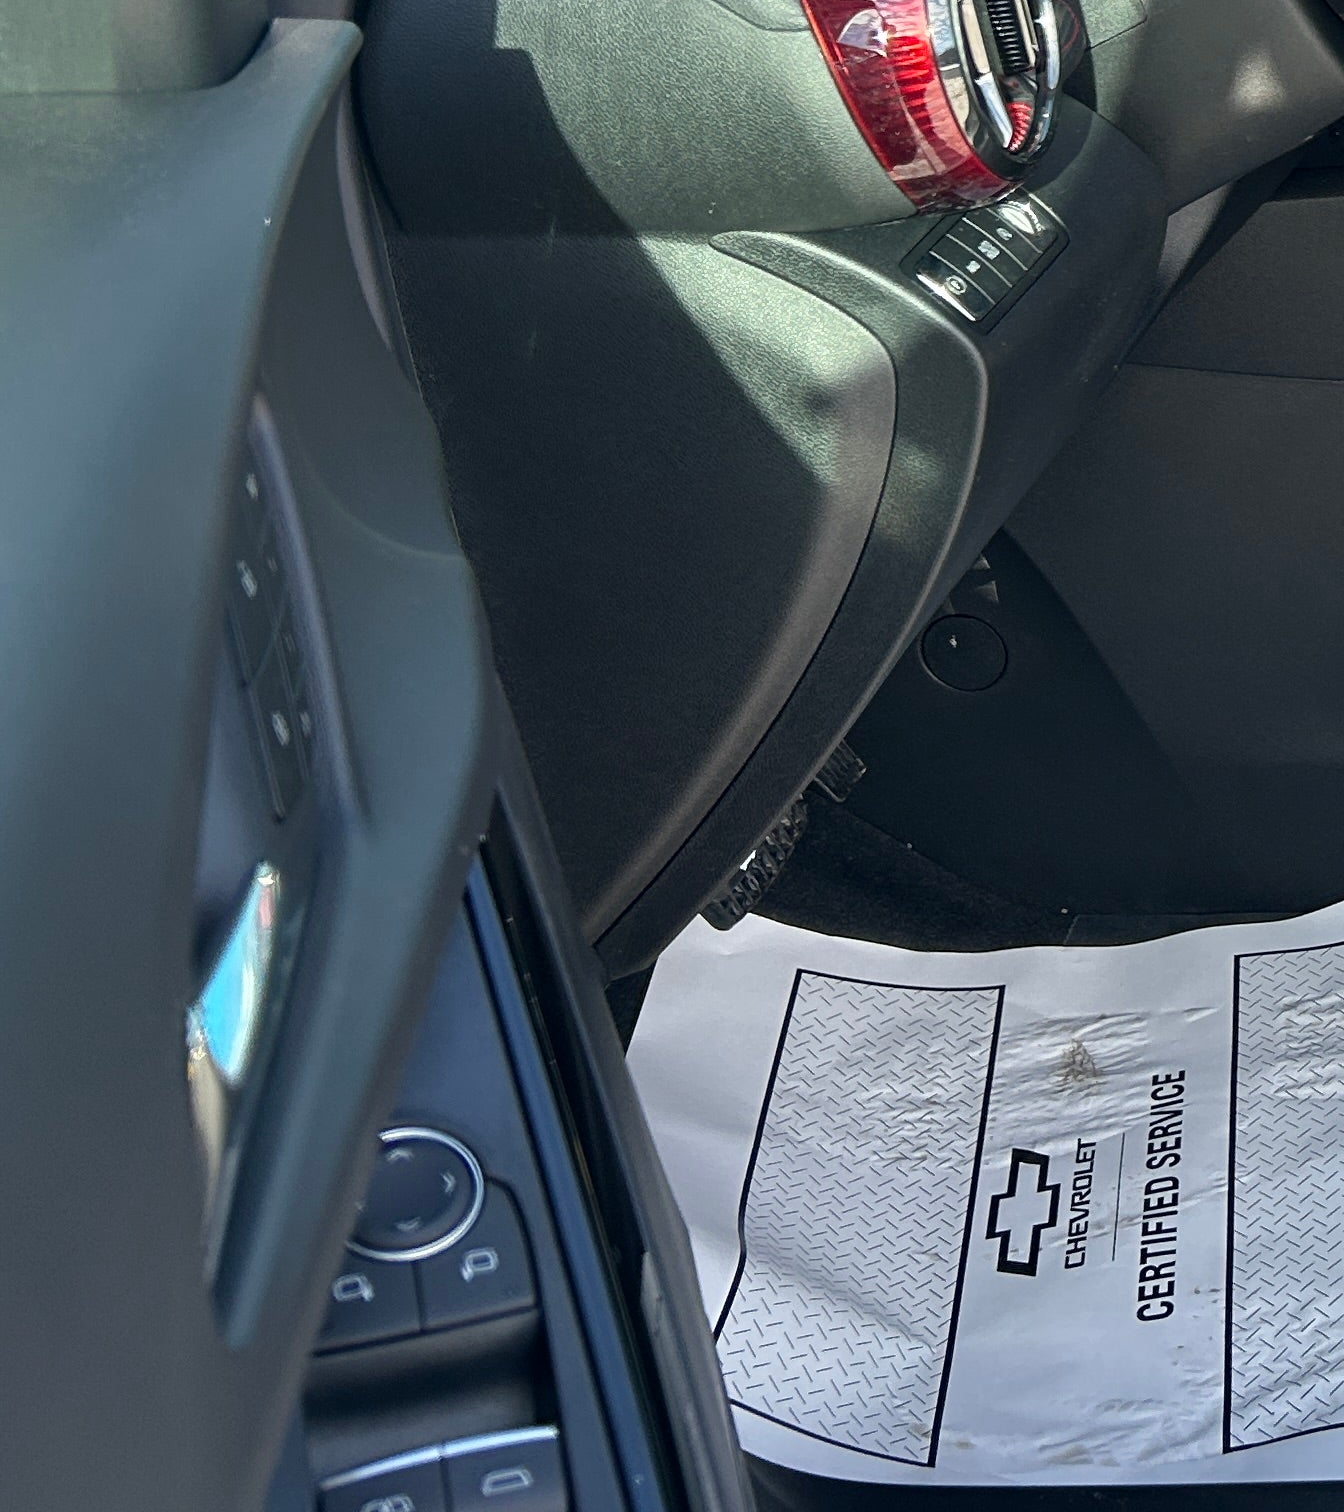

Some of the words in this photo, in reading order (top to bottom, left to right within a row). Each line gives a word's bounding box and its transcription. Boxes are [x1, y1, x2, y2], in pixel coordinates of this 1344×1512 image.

[1146, 1069, 1186, 1170] SERVICE
[1064, 1137, 1097, 1269] CHEVROLET
[1136, 1175, 1180, 1322] CERTIFIED
